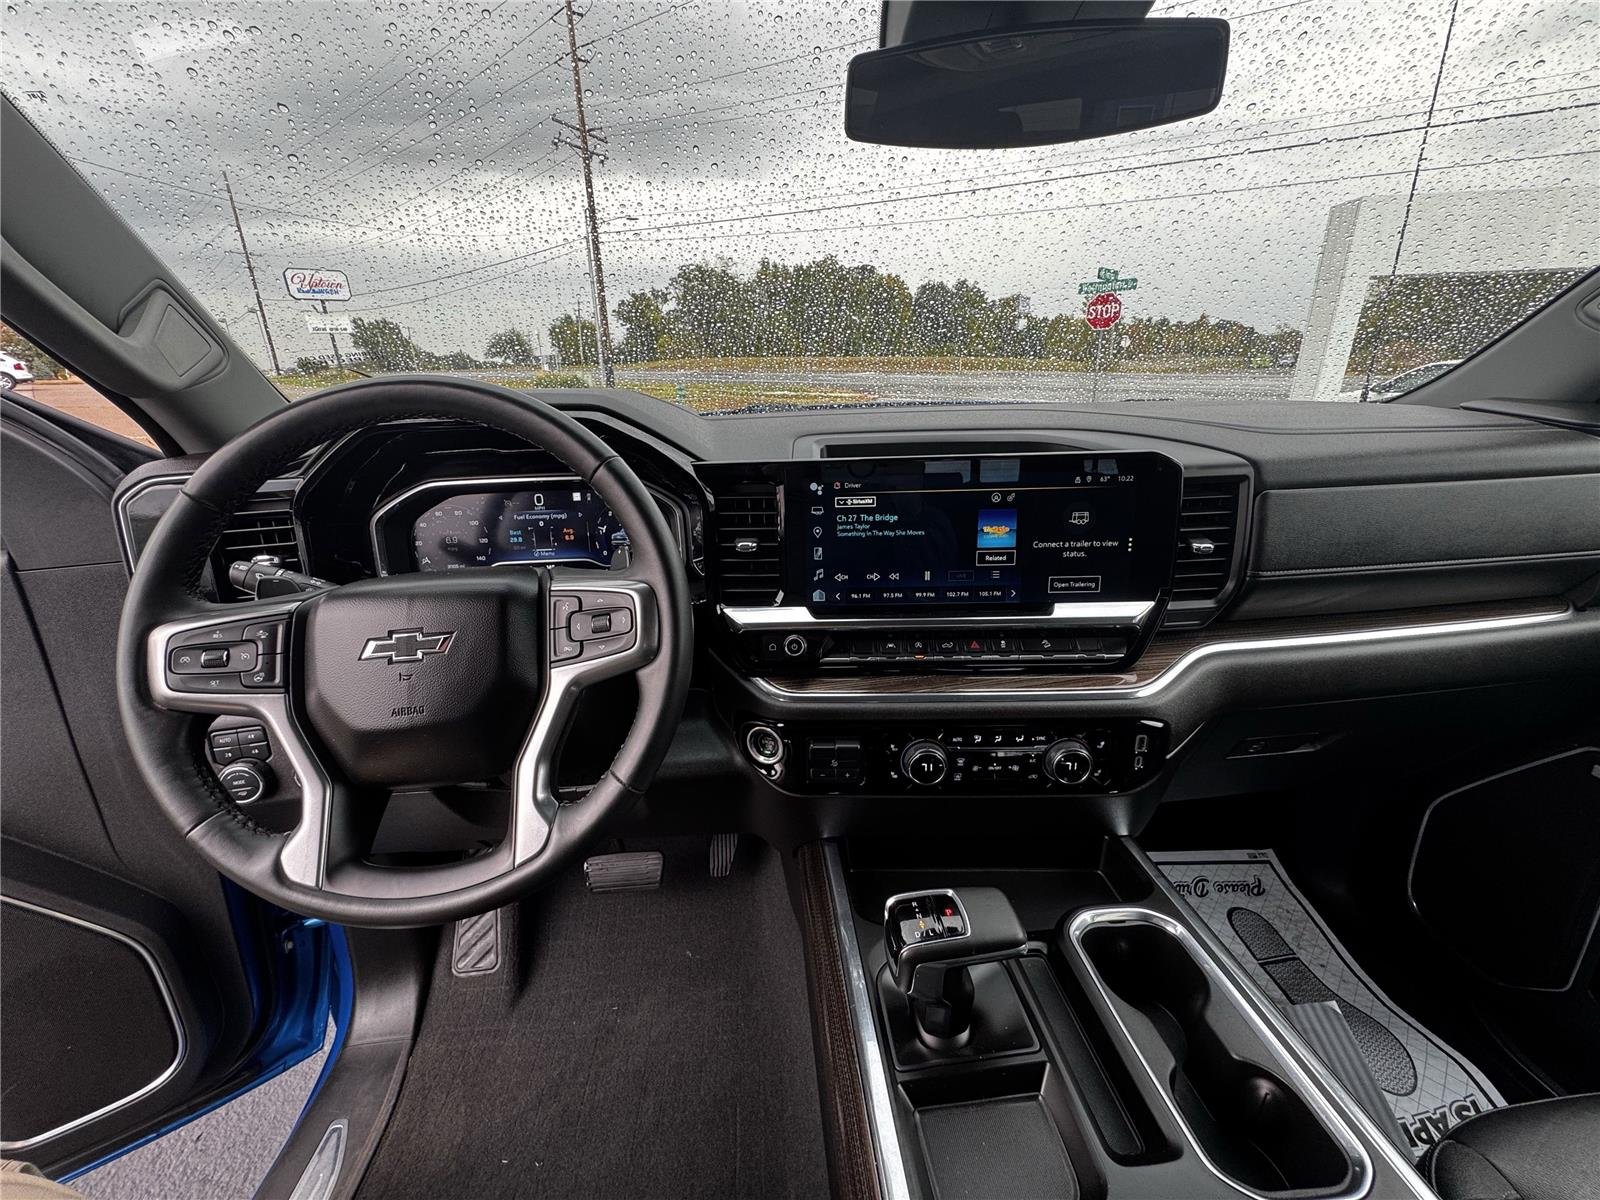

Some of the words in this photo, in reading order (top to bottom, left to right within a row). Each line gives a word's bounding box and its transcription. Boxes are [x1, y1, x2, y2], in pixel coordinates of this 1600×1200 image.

[291, 272, 342, 290] Uptown
[1087, 304, 1120, 319] STOP
[534, 494, 544, 506] 0
[875, 514, 898, 522] Bridge
[391, 704, 425, 717] AIRBAG
[922, 763, 933, 772] 71
[1213, 875, 1266, 896] Please
